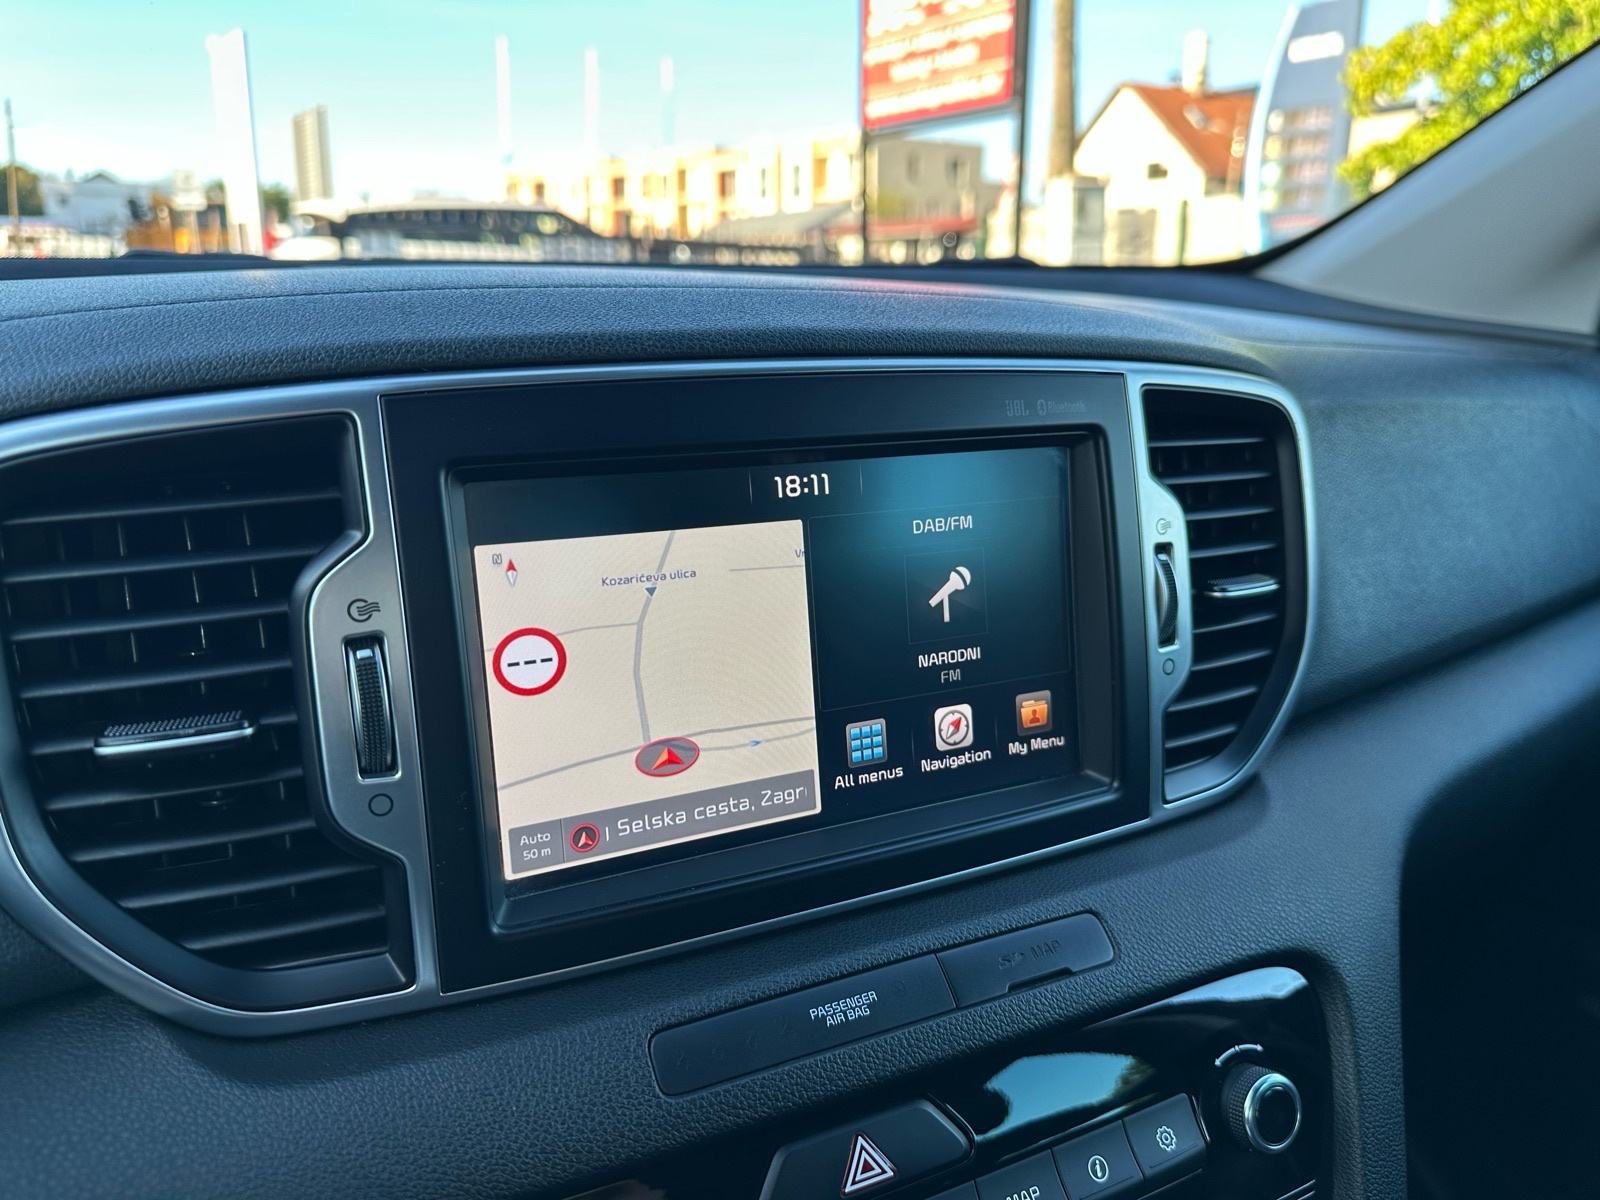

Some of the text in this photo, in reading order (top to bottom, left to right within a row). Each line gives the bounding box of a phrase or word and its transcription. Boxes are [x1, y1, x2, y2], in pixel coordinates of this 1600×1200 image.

[774, 473, 830, 498] 18:11
[912, 515, 973, 534] DAB/FM
[669, 569, 697, 580] ulica
[918, 646, 981, 668] NARODNI
[940, 668, 961, 683] FM
[1008, 735, 1065, 756] My Menu
[921, 749, 992, 772] Navigation
[834, 766, 904, 790] All menus
[617, 810, 687, 836] Selska
[694, 796, 755, 820] cesta,
[761, 786, 807, 806] Zagr
[520, 832, 551, 846] Auto
[523, 847, 551, 860] 50 m
[809, 990, 878, 1020] PASSENGER
[826, 1004, 870, 1028] AIR BAG
